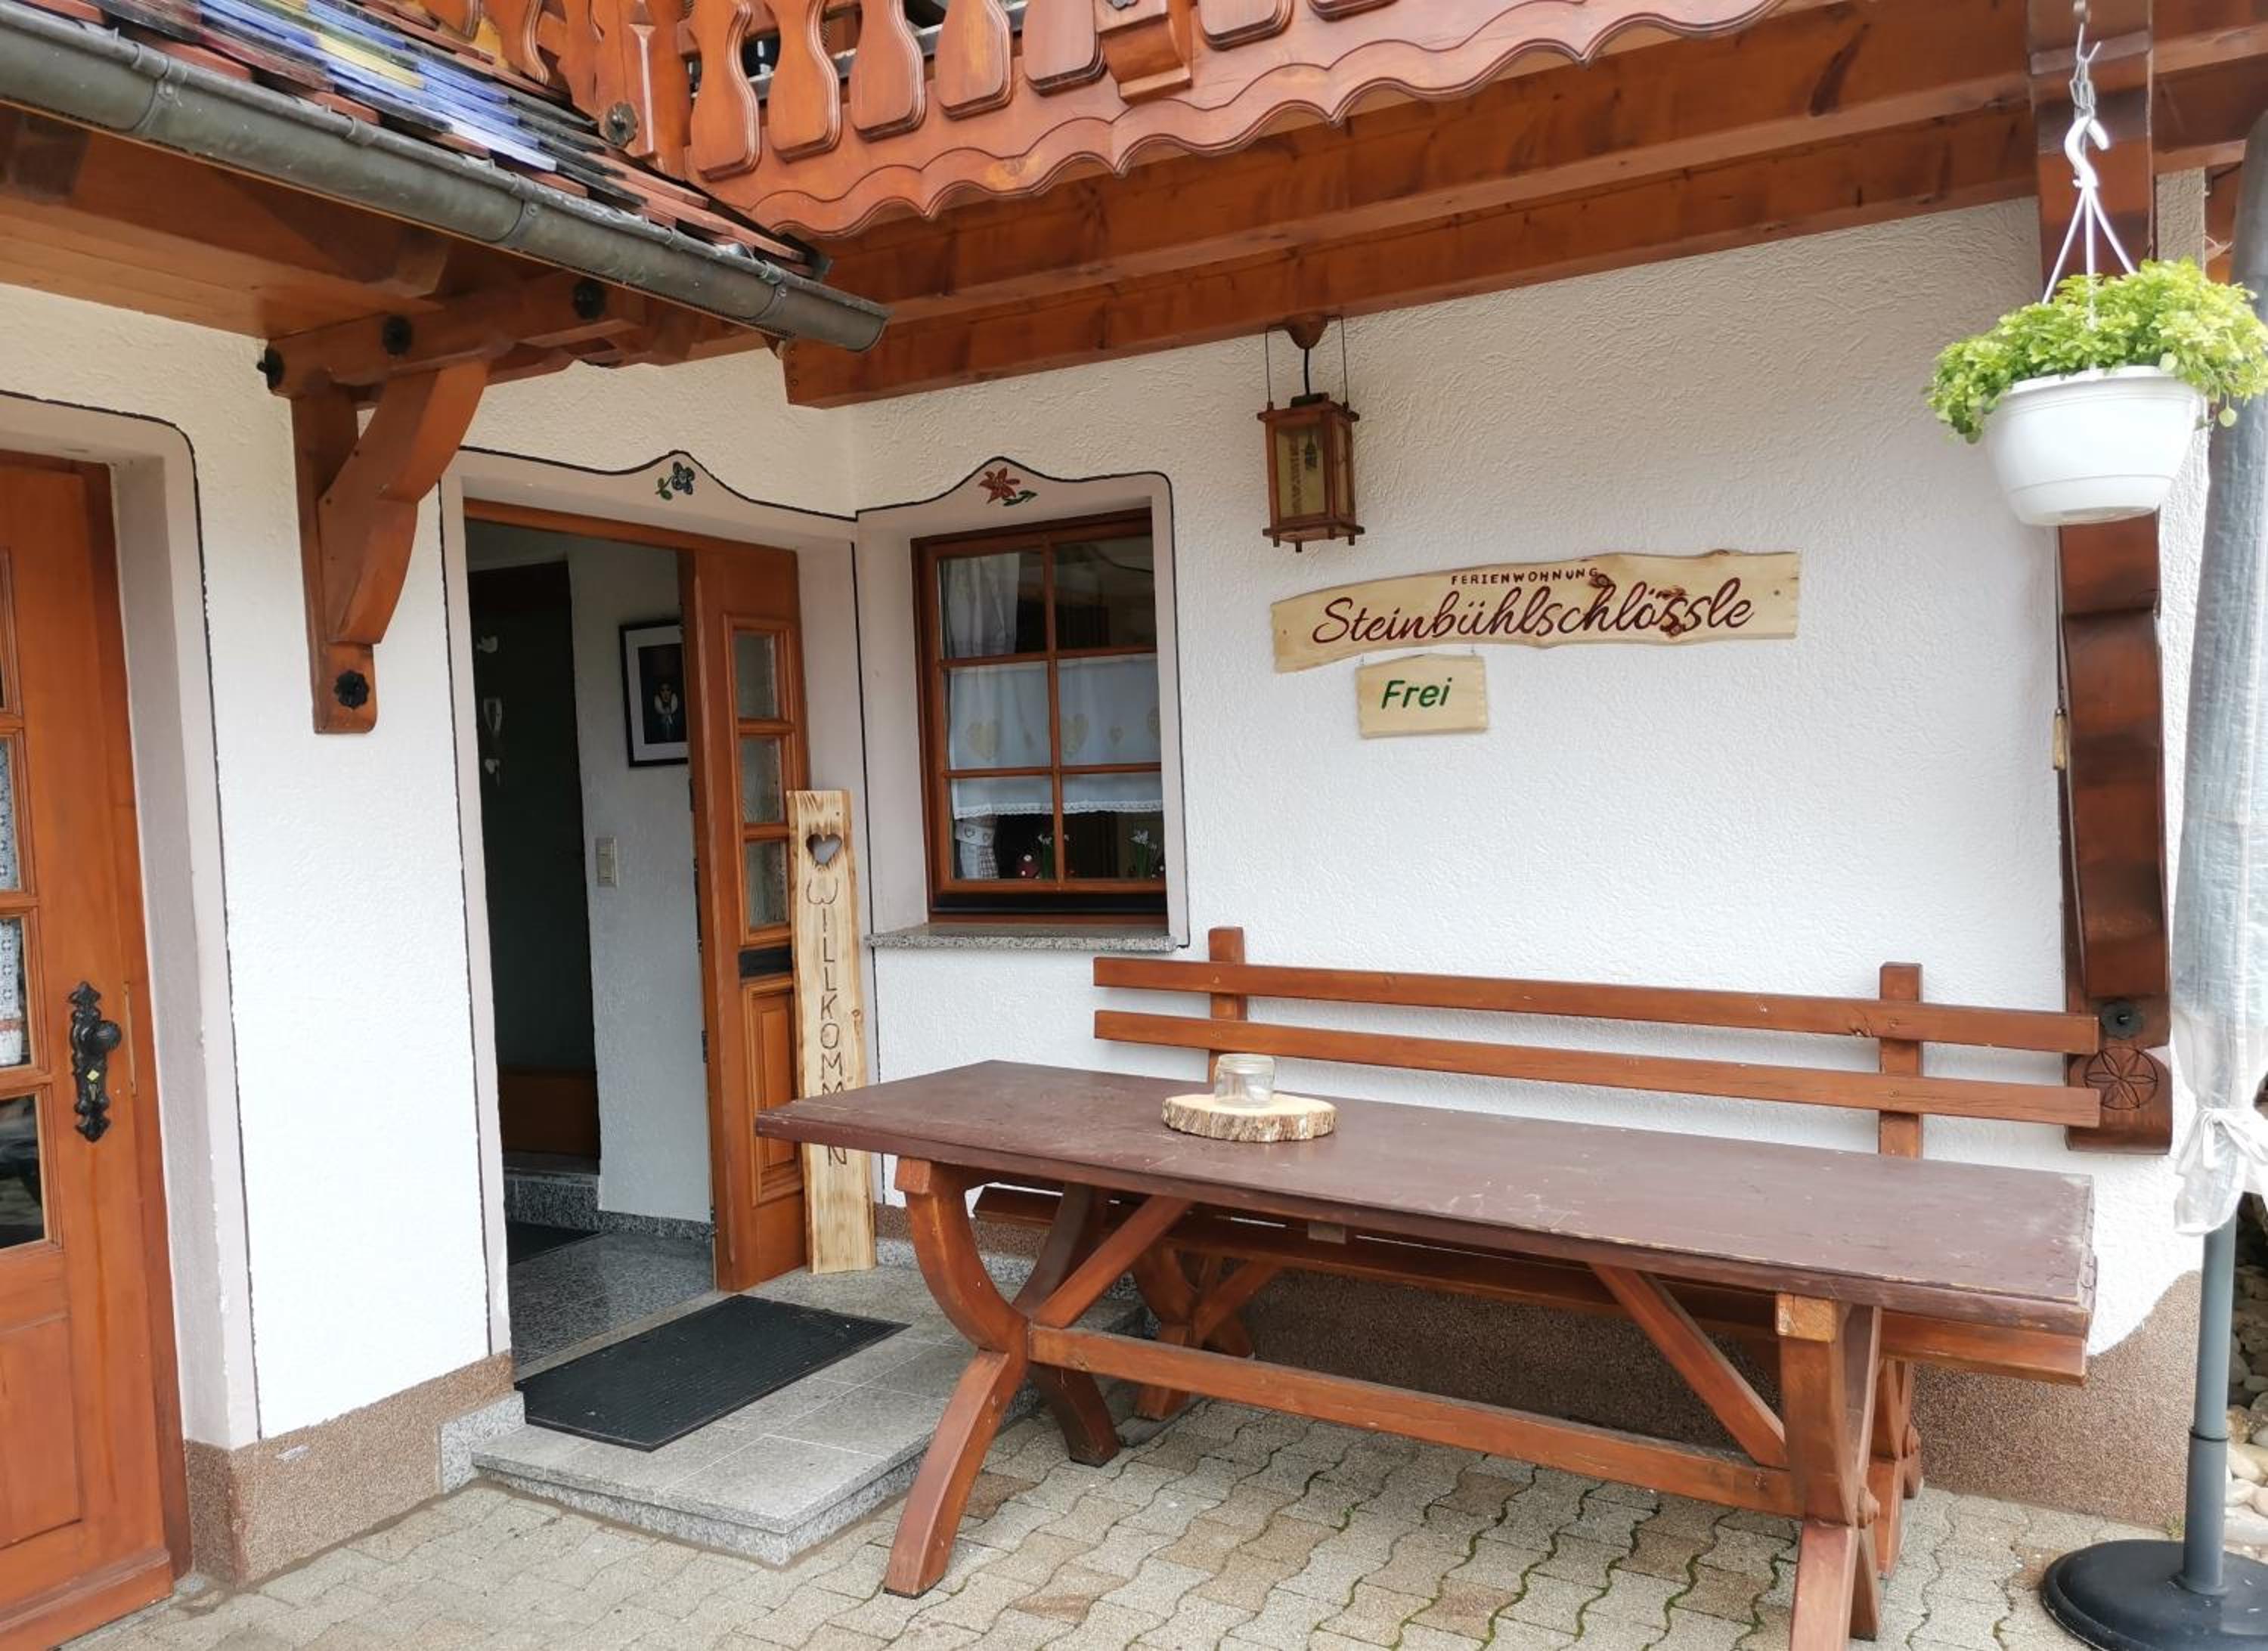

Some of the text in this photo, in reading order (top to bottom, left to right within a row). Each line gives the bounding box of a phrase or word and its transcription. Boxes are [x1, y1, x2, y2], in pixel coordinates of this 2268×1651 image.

[1451, 568, 1598, 586] FERIENWOHNUNG
[1312, 577, 1755, 643] Steinbühlschlössle
[1380, 677, 1452, 710] Frei
[806, 877, 847, 1166] WILLKOMMN
